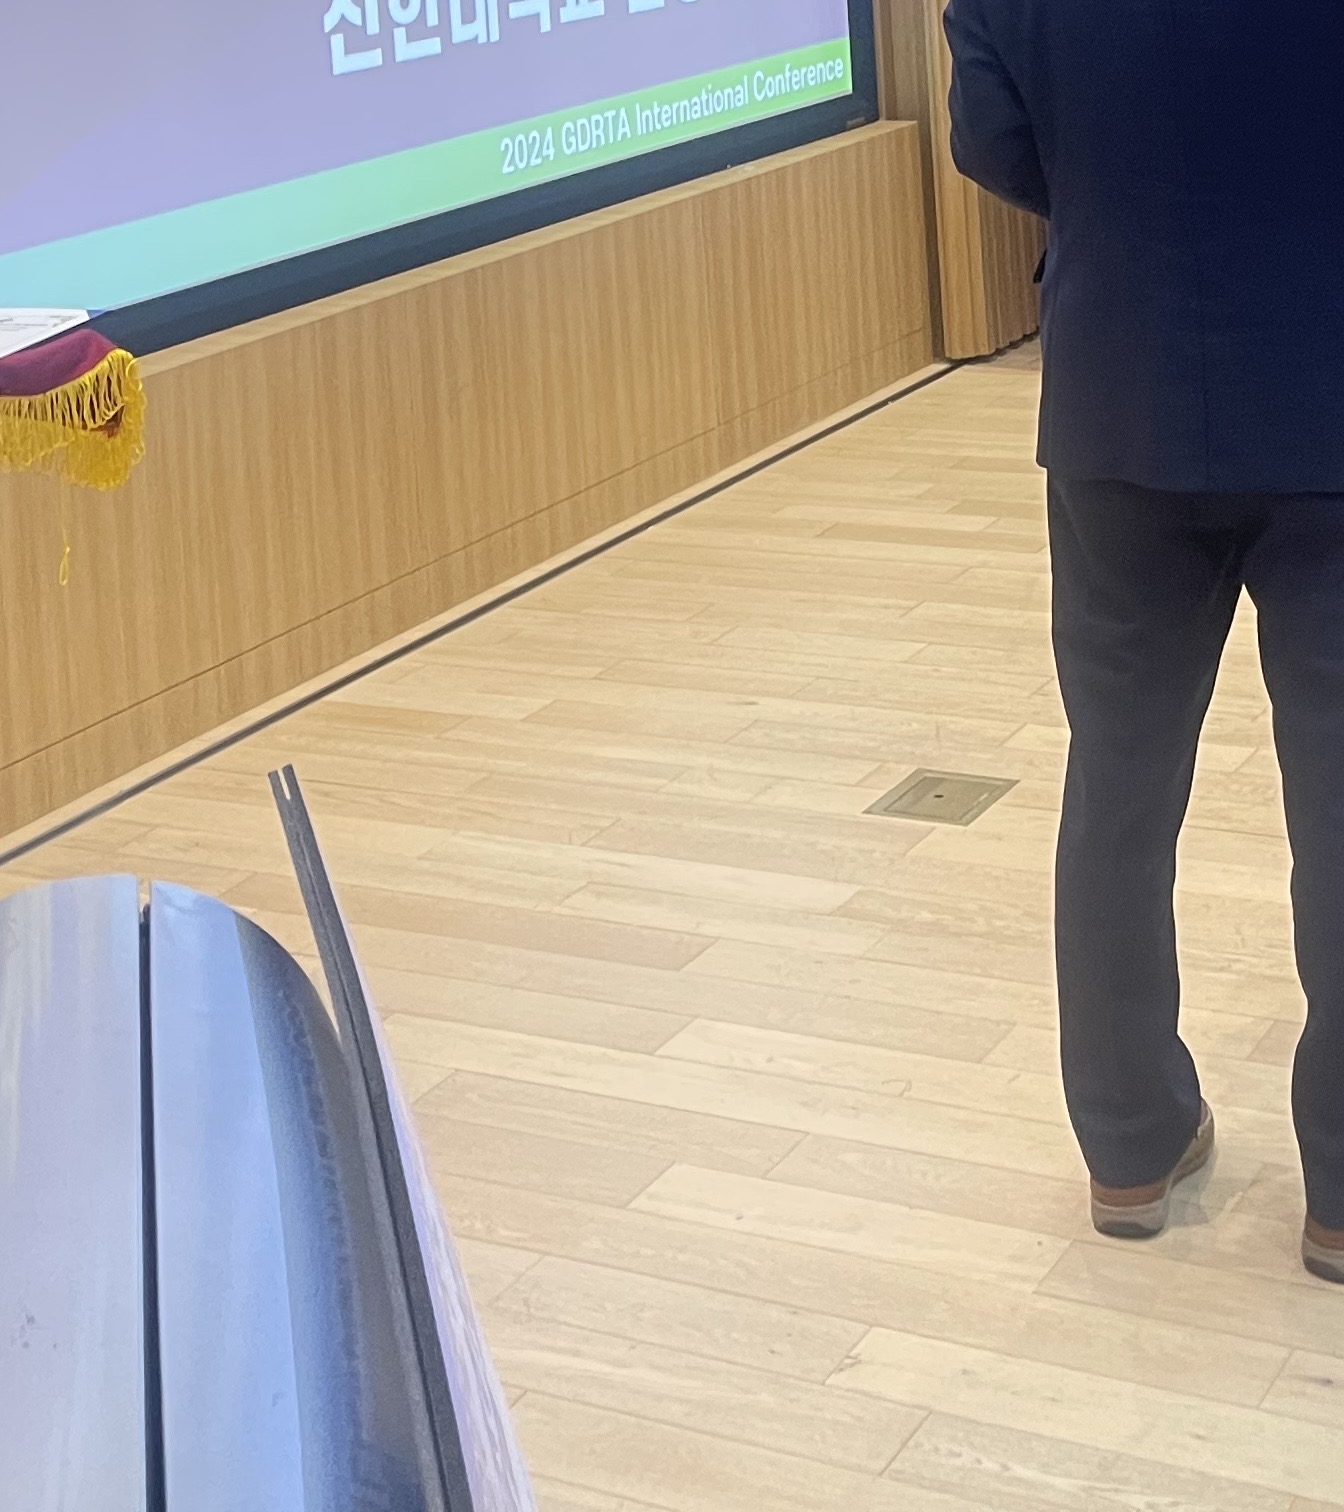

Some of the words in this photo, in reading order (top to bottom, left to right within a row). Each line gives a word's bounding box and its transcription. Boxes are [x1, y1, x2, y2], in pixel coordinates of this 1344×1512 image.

[500, 131, 556, 175] 2024
[560, 106, 632, 157] GDRTA
[635, 74, 751, 136] International
[752, 54, 845, 103] Conference
